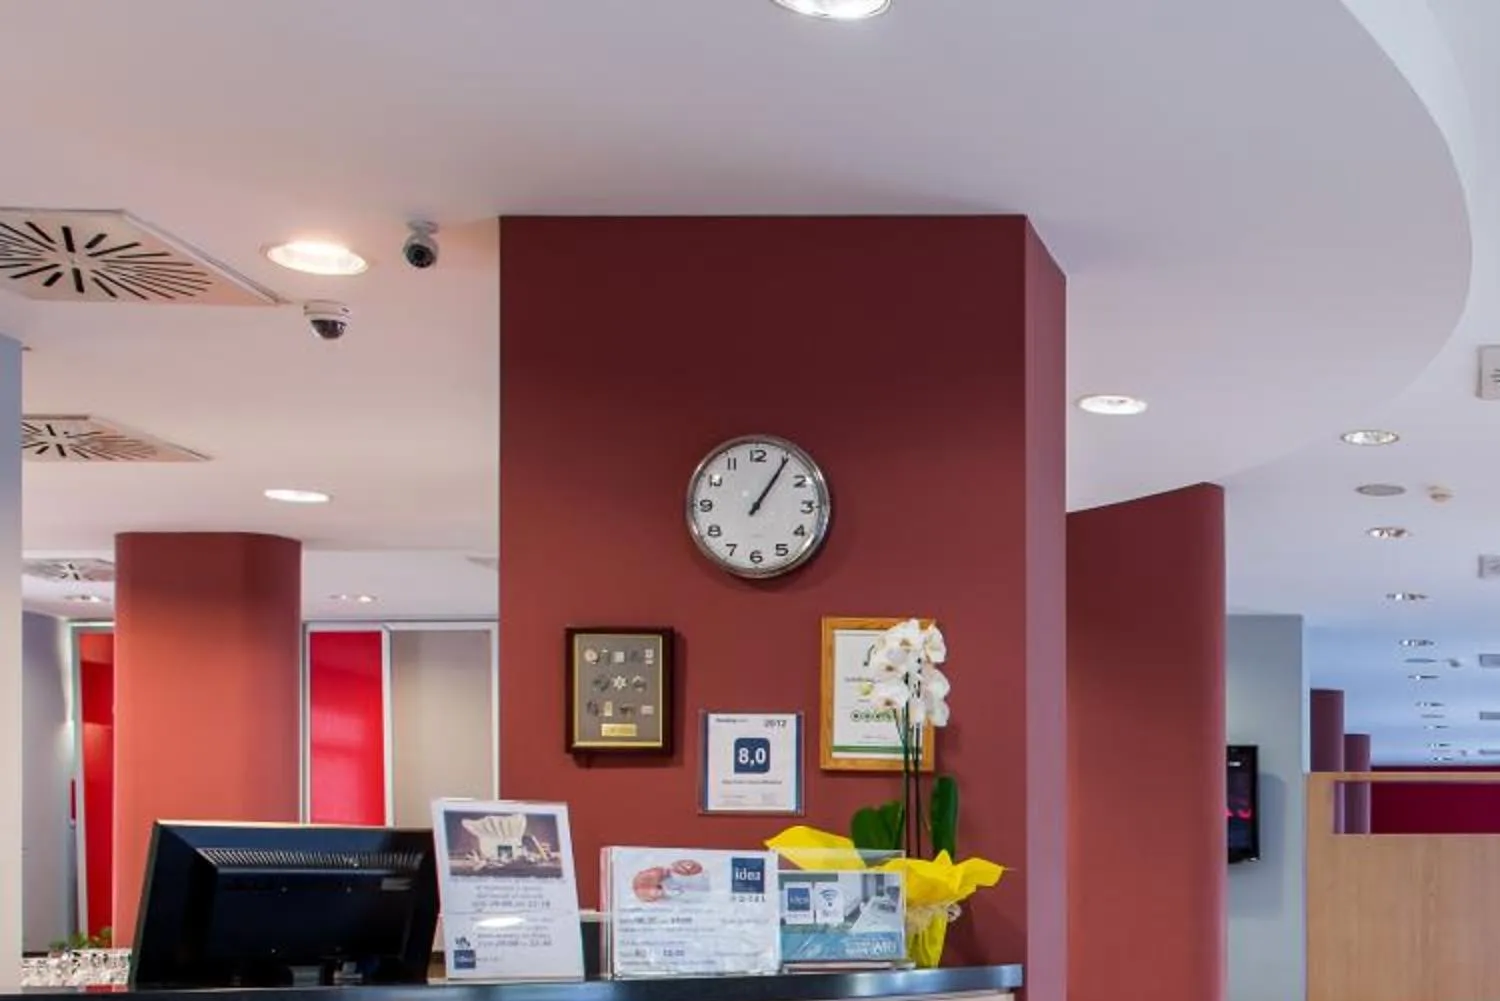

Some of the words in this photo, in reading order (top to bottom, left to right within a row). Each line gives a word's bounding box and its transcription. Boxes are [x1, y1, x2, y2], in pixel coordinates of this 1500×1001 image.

[749, 449, 767, 463] 12
[727, 458, 737, 471] 11
[709, 474, 722, 487] 10
[793, 475, 806, 488] 2
[700, 499, 713, 512] 9
[800, 500, 814, 514] 3
[707, 524, 721, 537] 8
[793, 525, 805, 537] 4
[726, 543, 737, 556] 7
[775, 543, 789, 557] 5
[749, 550, 763, 564] 6
[738, 747, 766, 768] 8,0
[735, 867, 761, 881] idea
